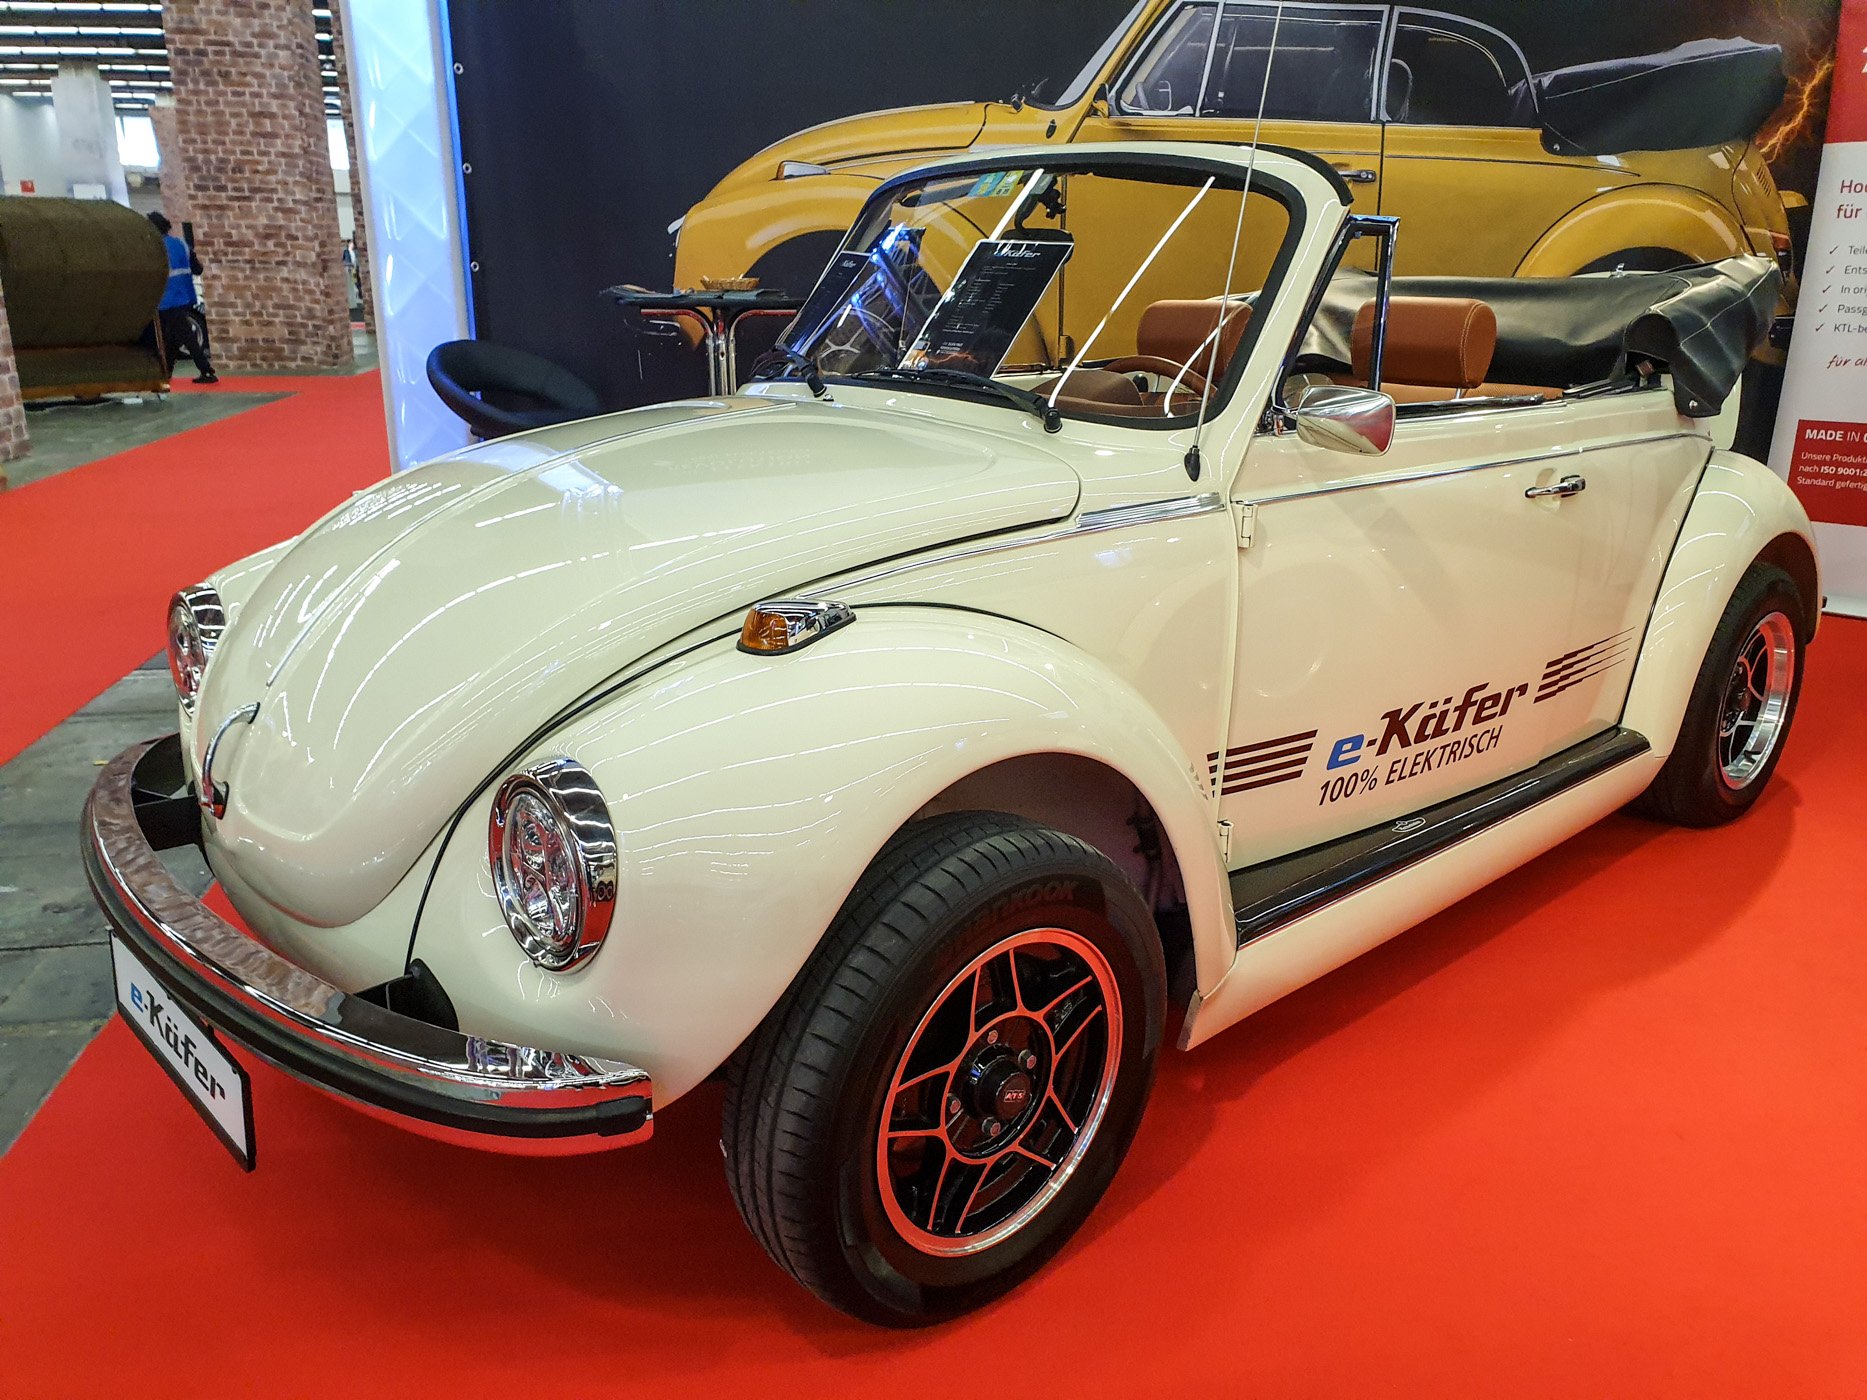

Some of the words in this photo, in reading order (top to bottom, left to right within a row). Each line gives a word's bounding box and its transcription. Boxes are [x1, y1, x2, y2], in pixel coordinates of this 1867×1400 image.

[1840, 179, 1867, 194] Ho
[1836, 203, 1863, 219] für
[1840, 284, 1851, 294] In
[1826, 354, 1852, 370] für
[1804, 429, 1845, 442] MADE
[1846, 430, 1861, 443] IN
[1801, 451, 1831, 462] Unsere
[1832, 453, 1867, 465] Produkt
[1799, 464, 1819, 473] nach
[1820, 465, 1836, 475] ISO
[1796, 476, 1835, 488] Standard
[1326, 682, 1529, 771] e-Käfer
[1318, 765, 1378, 806] 100%
[1384, 724, 1503, 786] ELEKTRISCH
[130, 982, 226, 1101] e-Käfer
